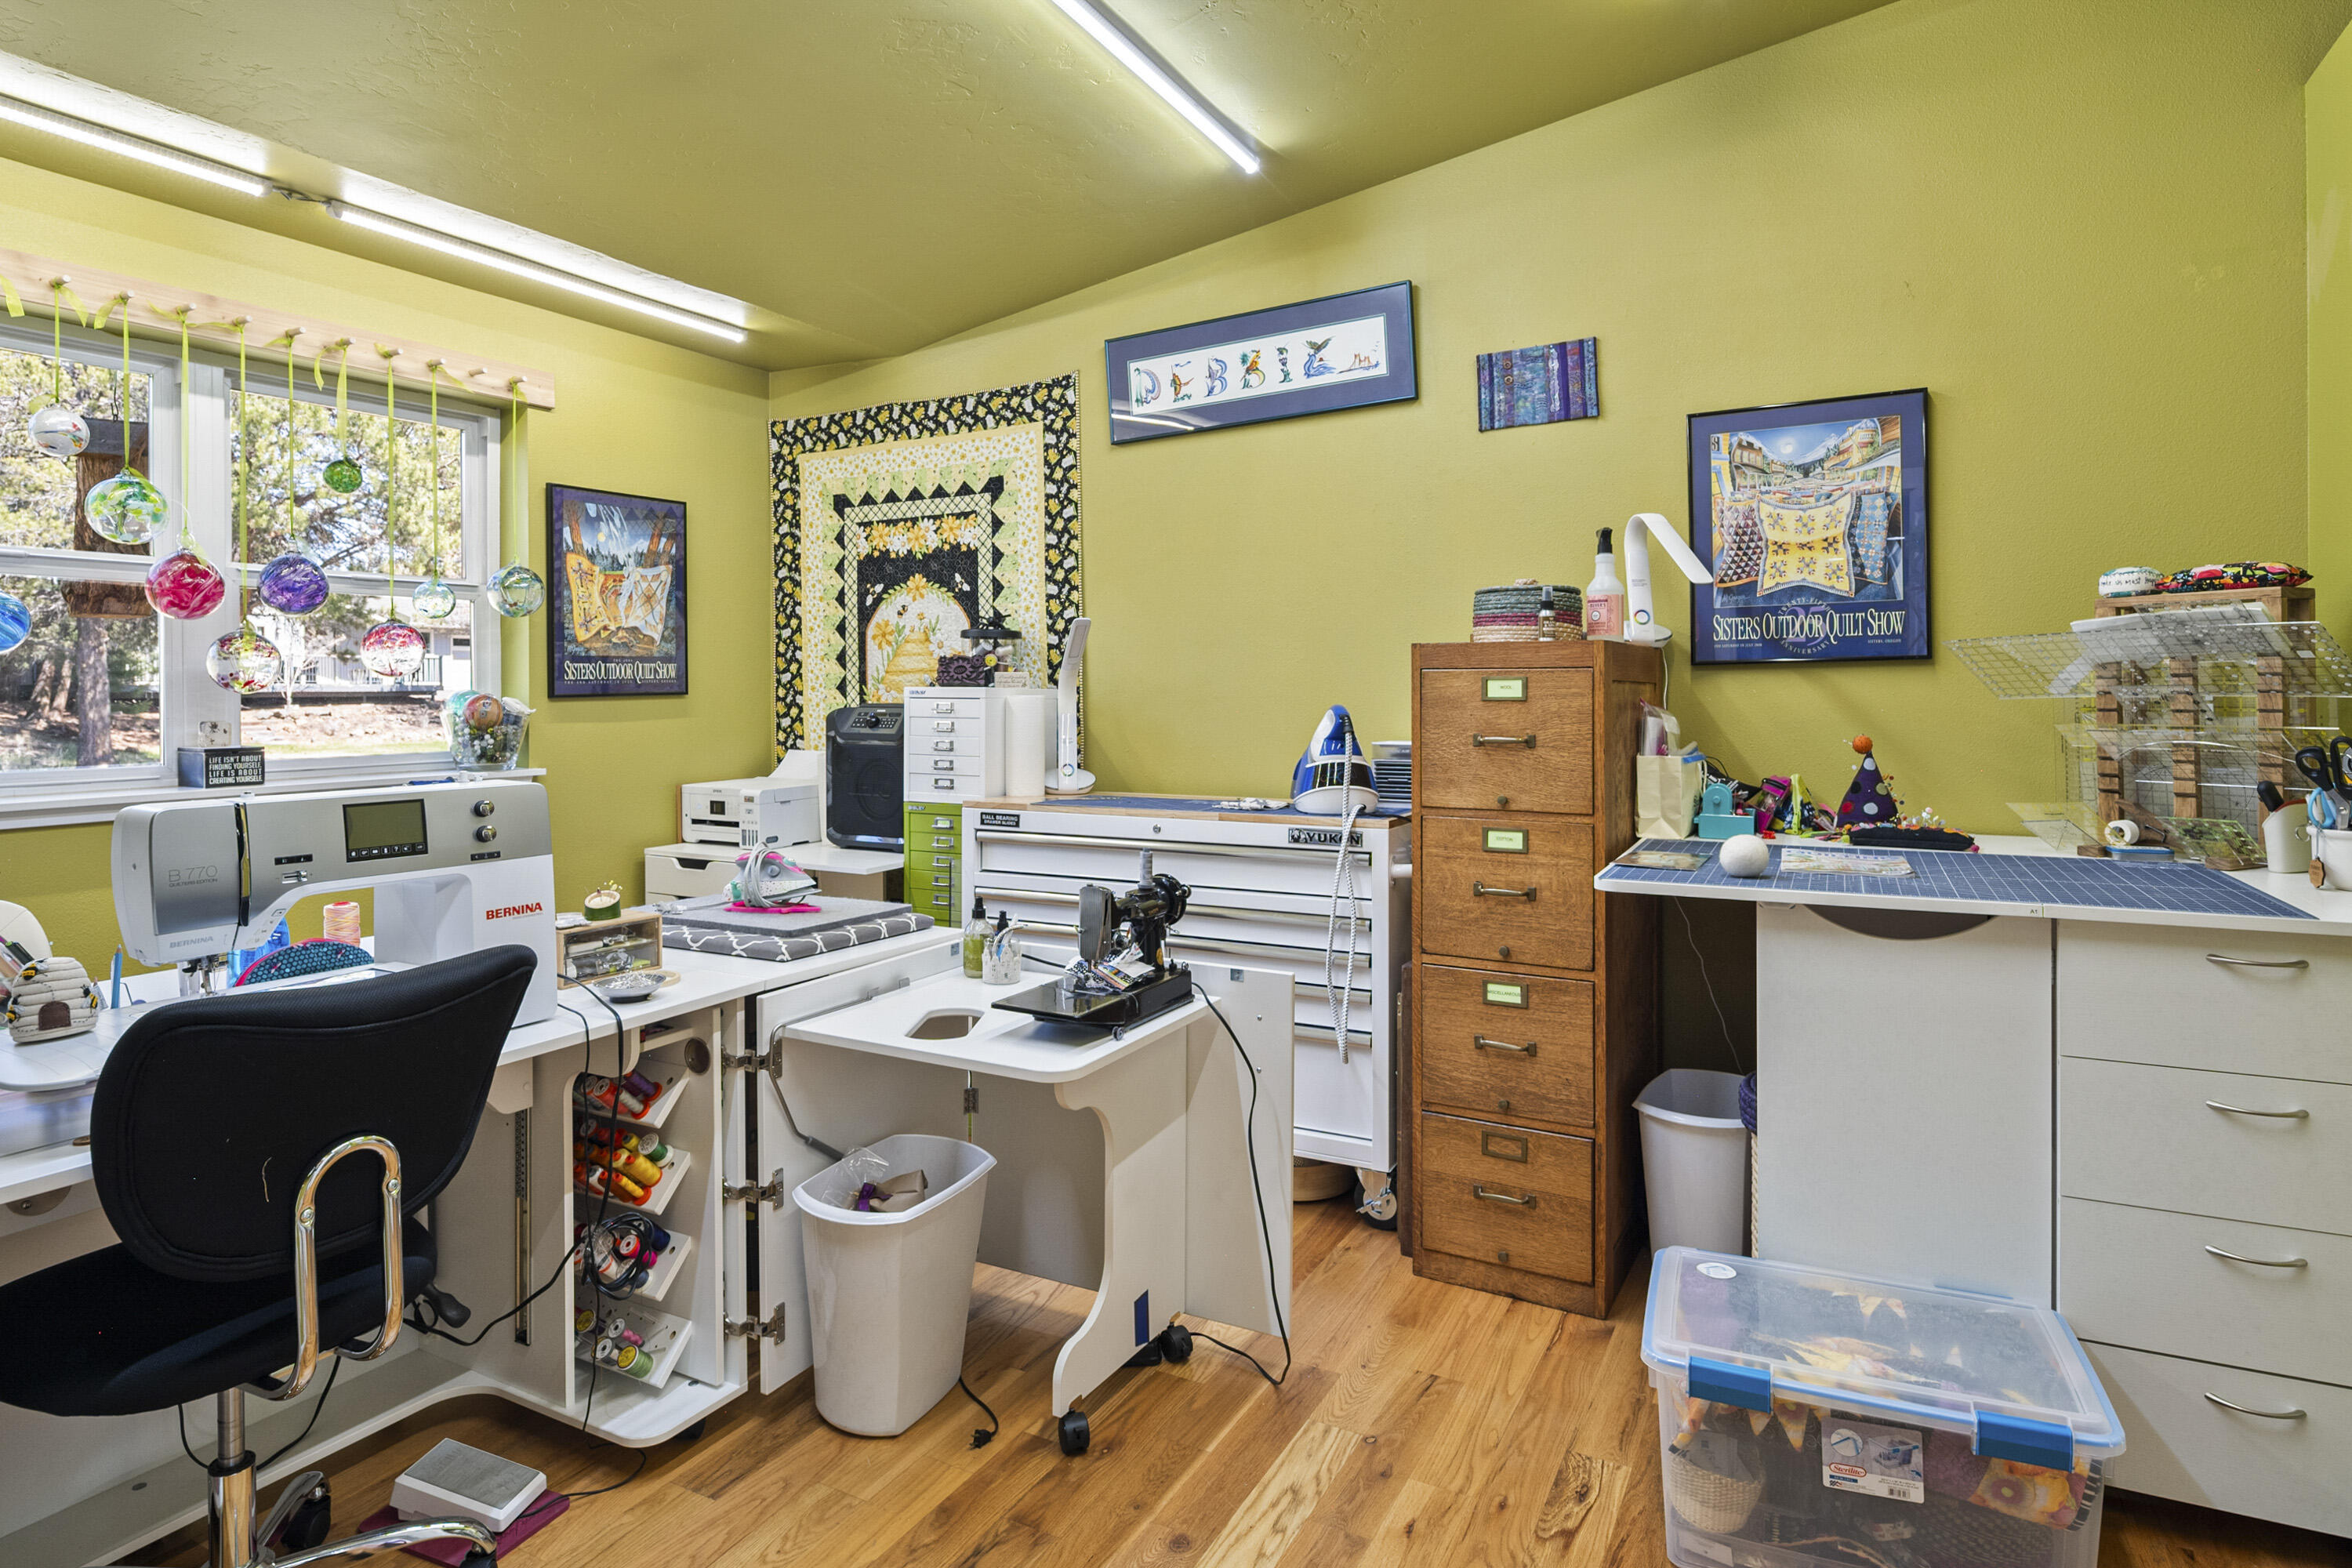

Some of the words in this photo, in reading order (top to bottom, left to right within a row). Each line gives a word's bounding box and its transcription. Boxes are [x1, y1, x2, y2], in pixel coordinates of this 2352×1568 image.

[1713, 614, 1761, 641] SISTERS
[1763, 612, 1824, 640] OUTDOOR
[1827, 610, 1865, 644] QUILT
[1867, 608, 1906, 637] SHOW
[564, 660, 596, 680] SISTERS
[597, 660, 633, 680] OUTDOOR
[634, 660, 656, 684] QUILT
[656, 660, 677, 680] SHOW
[169, 869, 181, 883] B
[186, 865, 218, 880] 770
[486, 902, 543, 920] BERNINA
[169, 936, 214, 949] BERNINA
[1834, 1465, 1864, 1475] Sterilite
